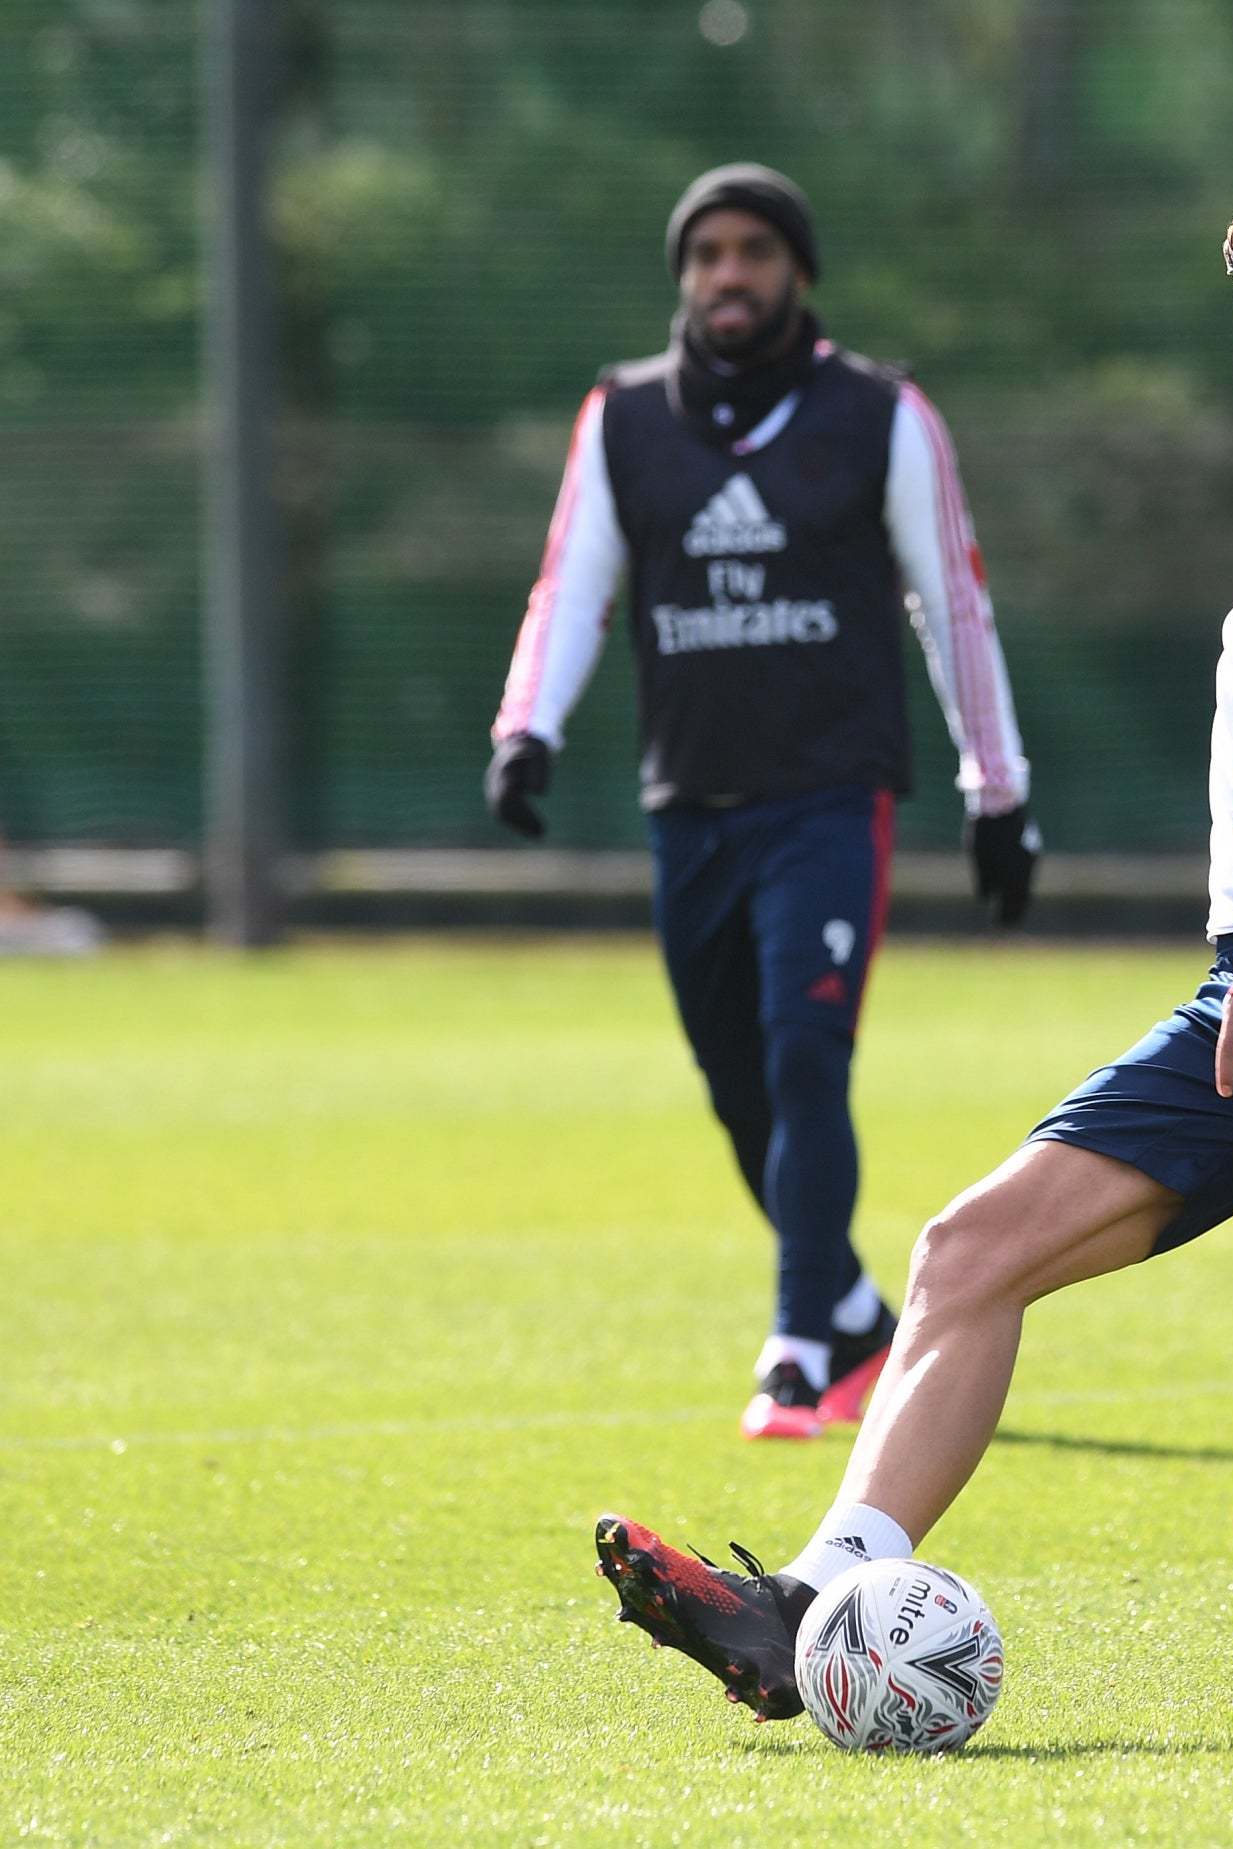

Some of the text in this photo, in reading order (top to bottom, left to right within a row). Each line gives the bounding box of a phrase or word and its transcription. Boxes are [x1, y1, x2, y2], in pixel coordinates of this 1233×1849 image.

[707, 559, 766, 604] Fly
[653, 600, 838, 655] Emirates
[822, 918, 856, 966] 9
[825, 1537, 872, 1562] adidas
[889, 1578, 931, 1646] mitre
